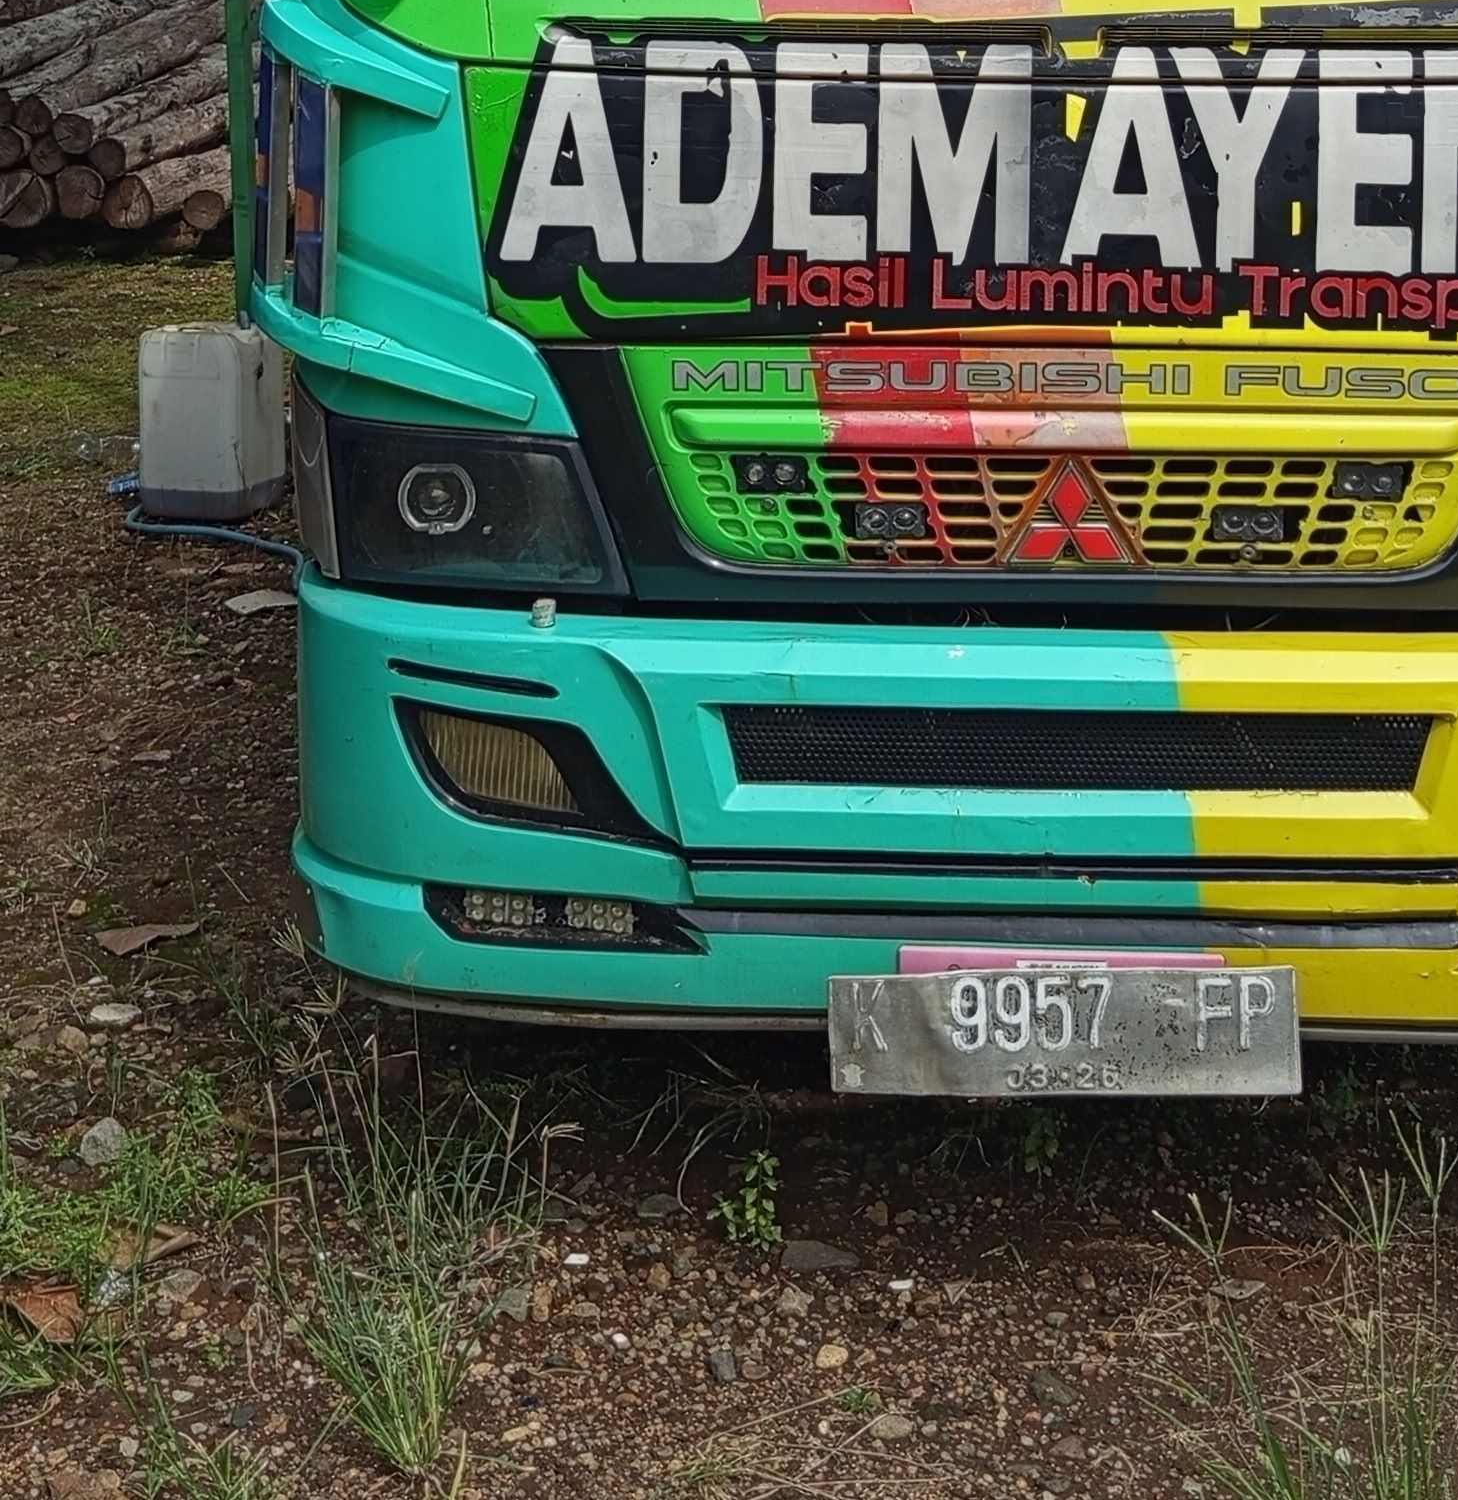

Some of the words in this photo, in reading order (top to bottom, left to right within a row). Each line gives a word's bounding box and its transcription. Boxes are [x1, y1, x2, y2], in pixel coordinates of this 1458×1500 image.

[500, 36, 1033, 266] ADEM
[756, 254, 905, 309] Hasil
[931, 257, 1214, 316] Lumintu
[671, 360, 1191, 396] MITSUBISHI
[852, 979, 888, 1052] K
[951, 975, 1116, 1052] 9957
